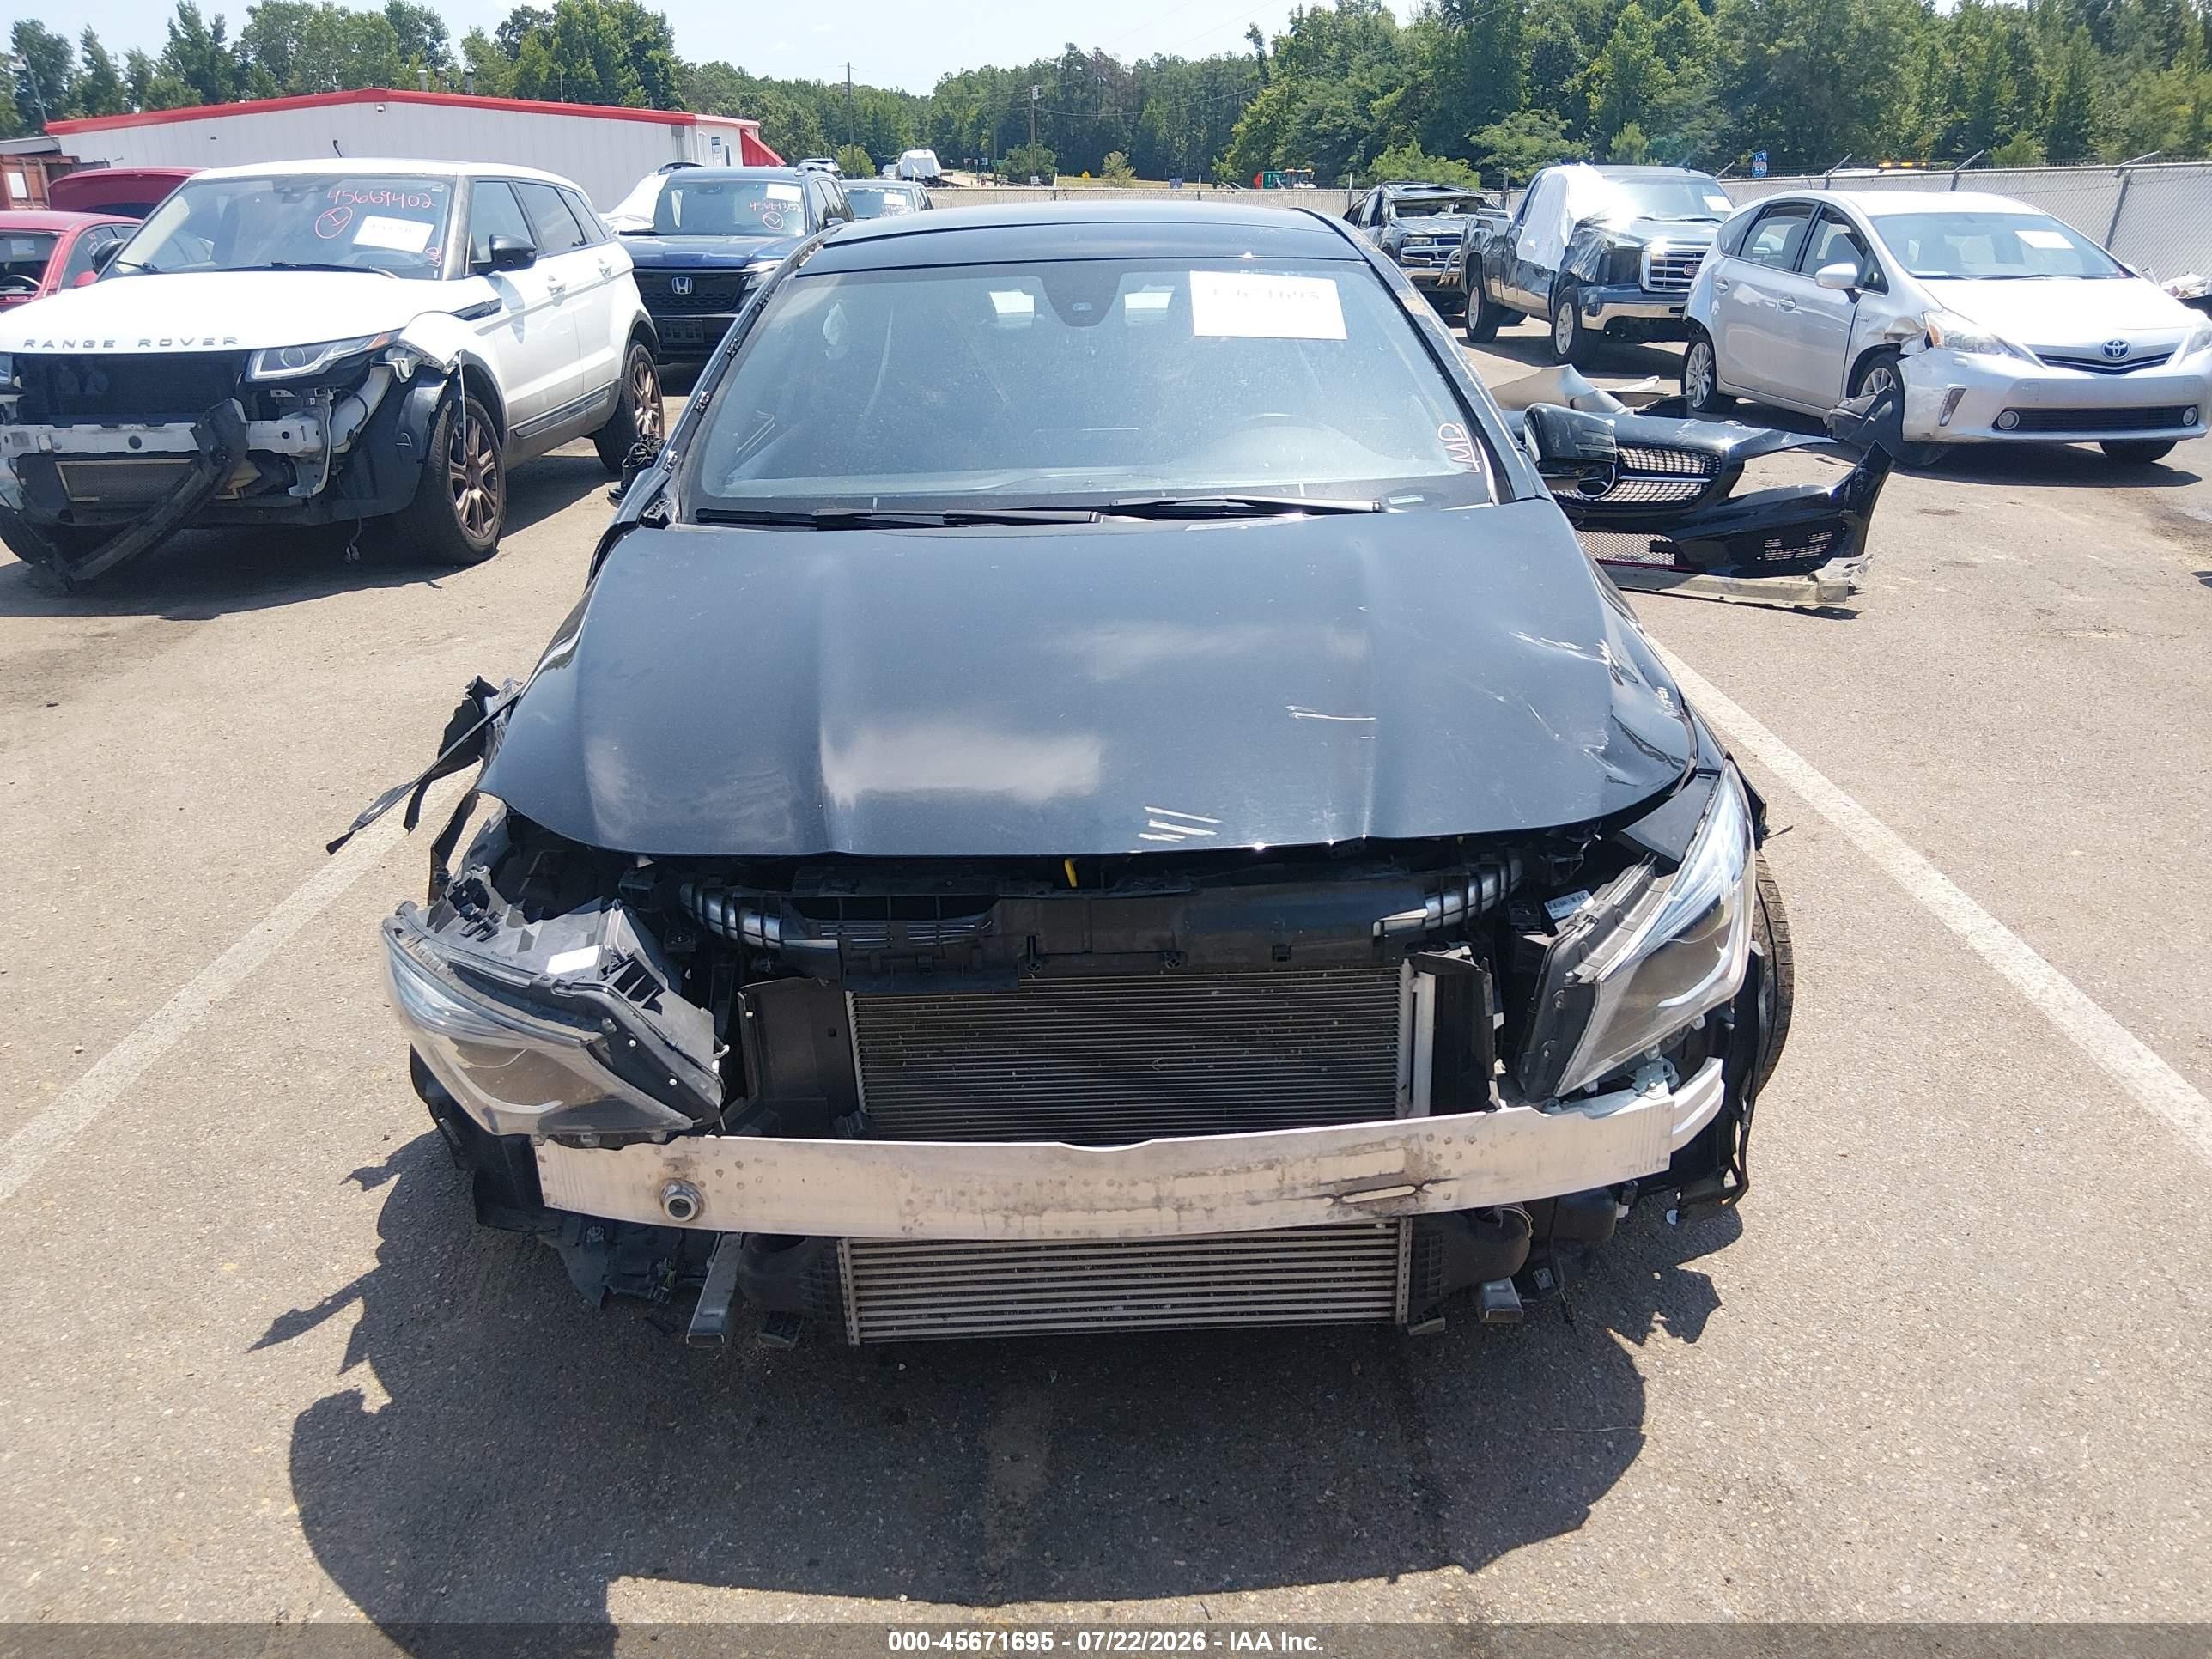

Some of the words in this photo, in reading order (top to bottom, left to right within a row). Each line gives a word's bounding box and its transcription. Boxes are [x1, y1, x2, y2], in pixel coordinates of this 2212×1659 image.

[1753, 152, 1766, 162] JCT
[327, 190, 436, 209] 45669402
[23, 339, 116, 349] RANGE
[137, 337, 238, 347] ROVER
